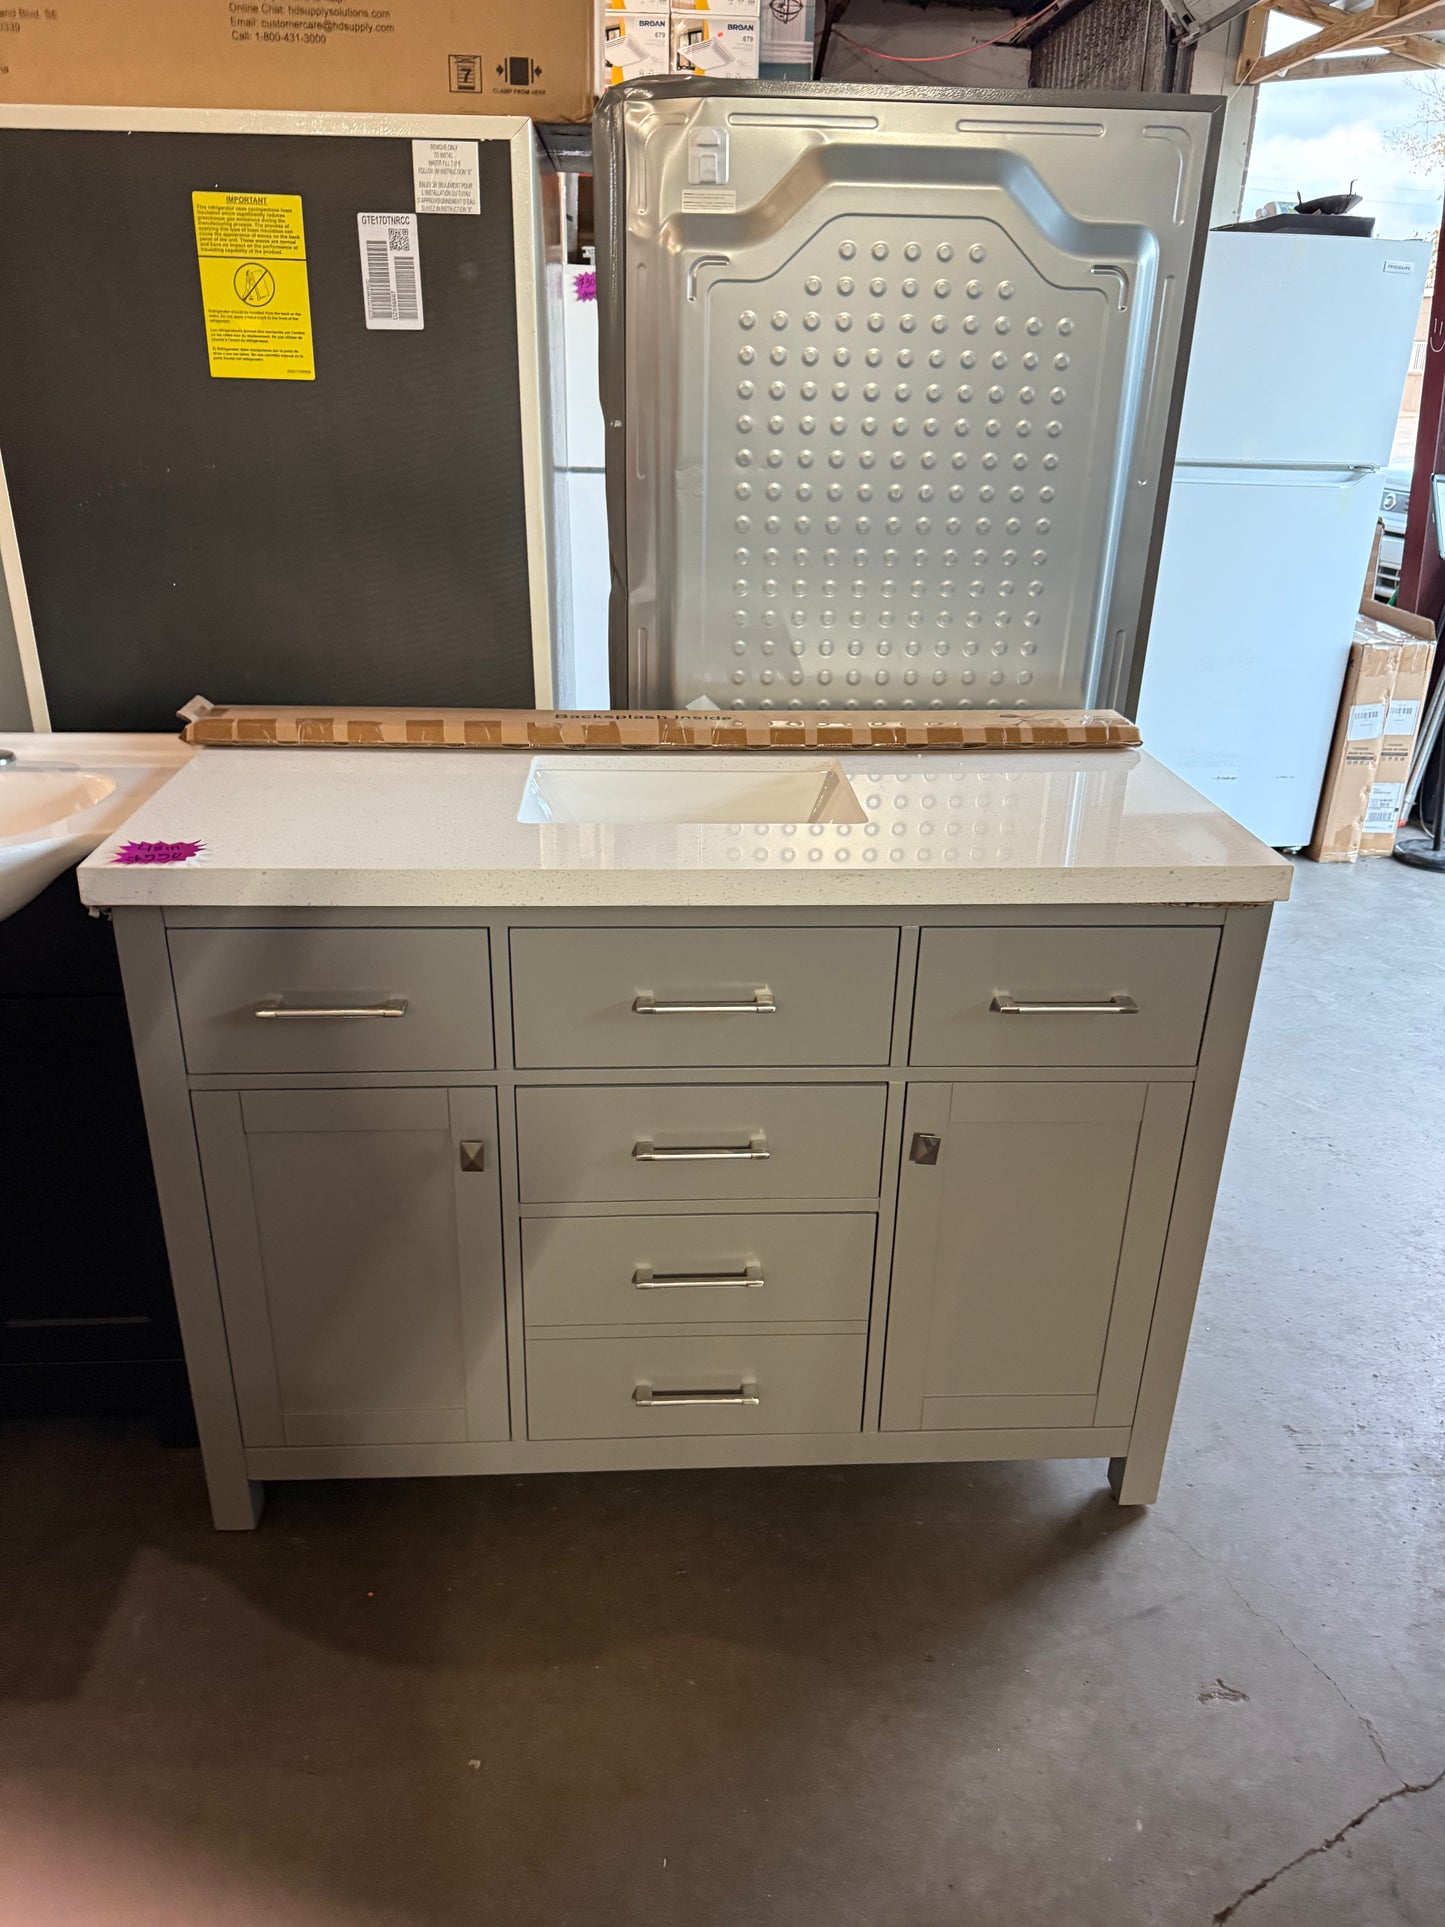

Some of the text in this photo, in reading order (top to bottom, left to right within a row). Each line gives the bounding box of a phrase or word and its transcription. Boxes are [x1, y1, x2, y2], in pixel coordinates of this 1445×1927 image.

[229, 2, 258, 13] Online
[261, 19, 395, 33] customercare@hdsupply.com
[256, 32, 326, 43] 1-800-431-3000
[226, 196, 267, 205] IMPORTANT
